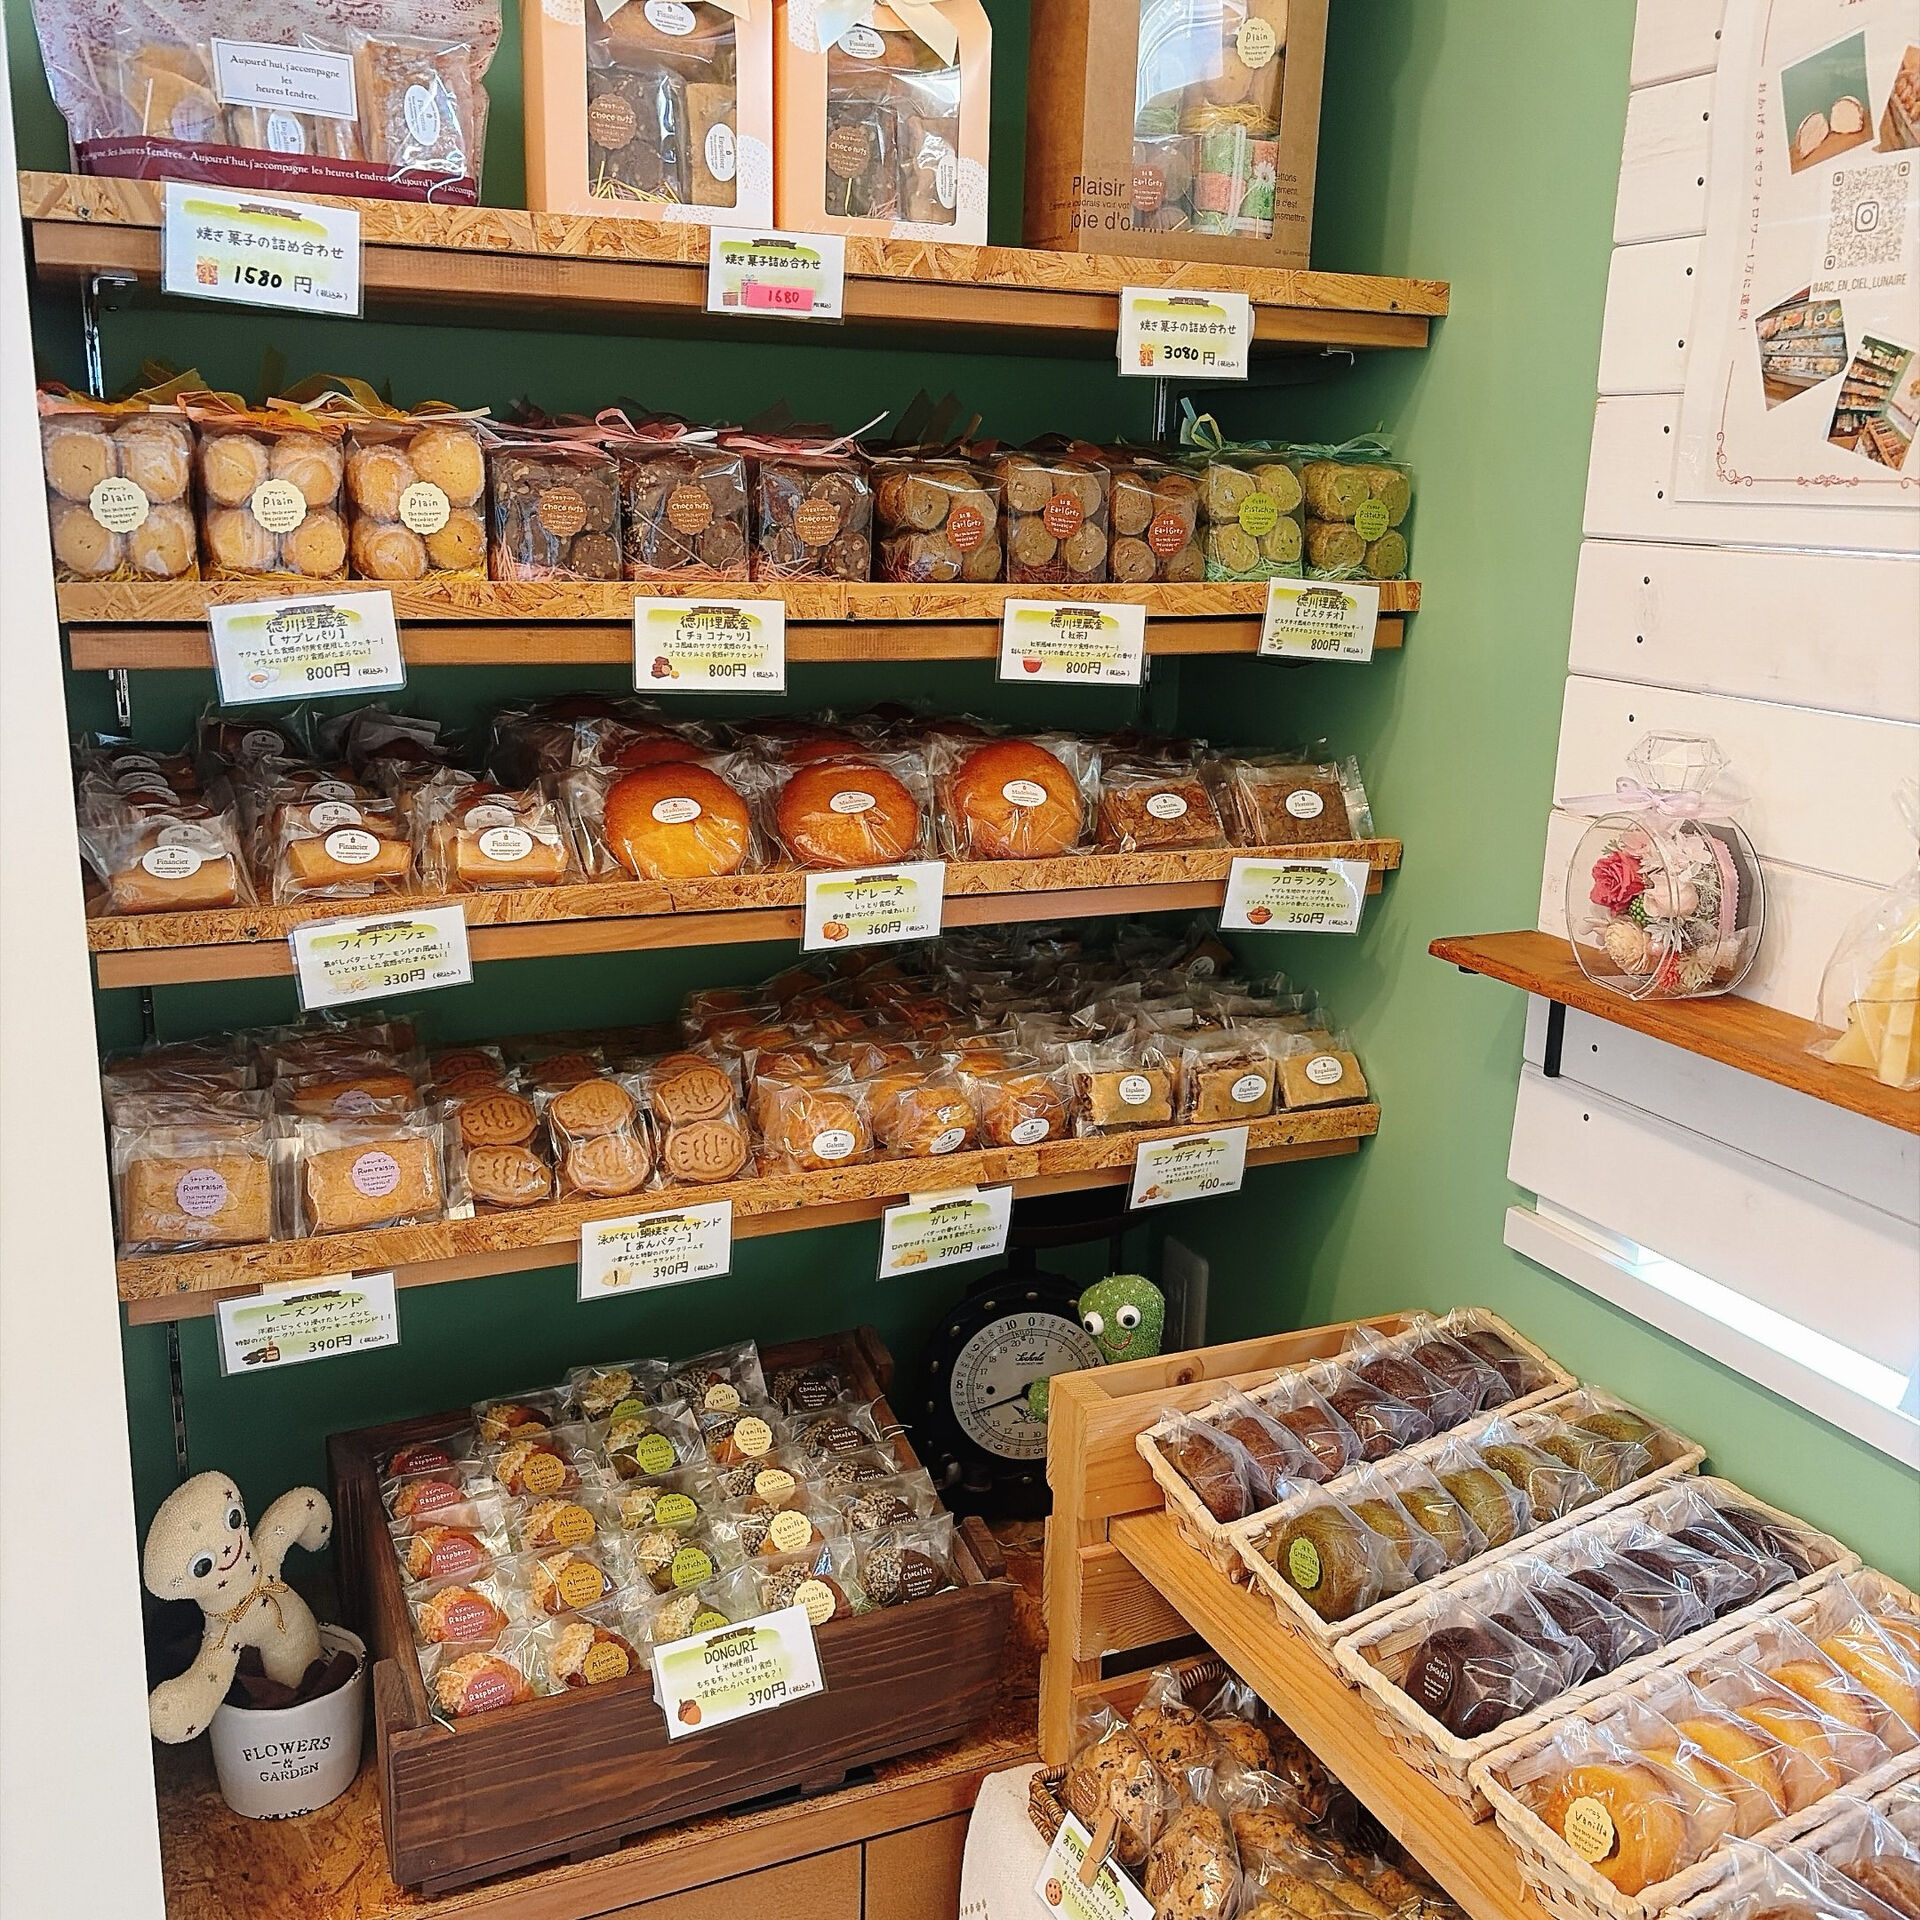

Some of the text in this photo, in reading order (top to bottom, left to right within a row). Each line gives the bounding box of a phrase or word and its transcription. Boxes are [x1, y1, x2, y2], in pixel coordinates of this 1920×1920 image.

[1245, 33, 1268, 42] Plain
[281, 76, 293, 85] les
[256, 84, 283, 95] heures
[590, 111, 634, 124] Choco nuts
[830, 143, 867, 156] Choco nuts
[311, 165, 323, 175] les
[325, 167, 355, 179] heures
[1072, 176, 1125, 197] Plaisir
[1070, 209, 1099, 233] joie
[196, 226, 344, 259] 焼き菓子の詰め合わせ
[725, 253, 821, 270] 焼き菓子詰め合わせ
[768, 290, 800, 304] 1680
[1140, 318, 1237, 335] 焼き菓子の詰め合わせ
[102, 493, 134, 505] Plain
[263, 496, 293, 508] Plain
[410, 498, 438, 508] Plain
[542, 504, 584, 513] Choco nuts
[799, 516, 821, 524] Choco
[1297, 595, 1350, 611] 徳川埋蔵金
[266, 612, 350, 633] 徳川埋蔵金
[680, 615, 752, 630] 徳川埋蔵金
[1050, 617, 1105, 631] 徳川埋蔵金
[1310, 638, 1341, 652] 800円
[306, 662, 350, 681] 800円
[709, 663, 747, 678] 800円
[1066, 661, 1101, 675] 800円
[156, 858, 188, 866] Financier
[1271, 875, 1337, 887] フロランタン
[844, 885, 904, 901] マドレーヌ
[1288, 912, 1325, 925] 350円
[867, 920, 901, 936] 360円
[337, 930, 427, 951] フィナンシェ
[383, 968, 426, 987] 330円
[1152, 1147, 1225, 1166] エンガディナー
[357, 1167, 374, 1175] Rum
[183, 1184, 200, 1192] Rum
[1198, 1178, 1219, 1191] 400
[930, 1210, 971, 1226] ガレット
[940, 1242, 973, 1258] 370円
[653, 1261, 689, 1278] 390円
[266, 1296, 364, 1323] レーズンサンド
[1005, 1319, 1017, 1331] 10
[1028, 1316, 1036, 1327] 0
[308, 1335, 352, 1353] 390円
[798, 1384, 827, 1393] Chocolate
[955, 1379, 964, 1389] 8
[709, 1393, 734, 1406] Vanilla
[739, 1428, 766, 1436] Vanilla
[828, 1430, 857, 1441] Chocolate
[409, 1456, 442, 1467] Raspberry
[530, 1464, 558, 1476] Almond
[759, 1472, 787, 1487] Vanilla
[419, 1491, 453, 1505] Raspberry
[559, 1517, 587, 1527] Almond
[775, 1519, 804, 1534] Vanilla
[435, 1549, 471, 1562] Raspberry
[566, 1574, 596, 1587] Almond
[903, 1567, 933, 1580] Chocolate
[448, 1610, 485, 1625] Raspberry
[704, 1637, 759, 1665] DONGURI
[592, 1653, 620, 1669] Almond
[715, 1654, 755, 1673] 【米粉使用】
[468, 1683, 505, 1702] Raspberry
[747, 1681, 787, 1706] 370円
[242, 1736, 331, 1762] FLOWERS
[259, 1762, 319, 1782] GARDEN
[1575, 1811, 1608, 1838] Vanilla
